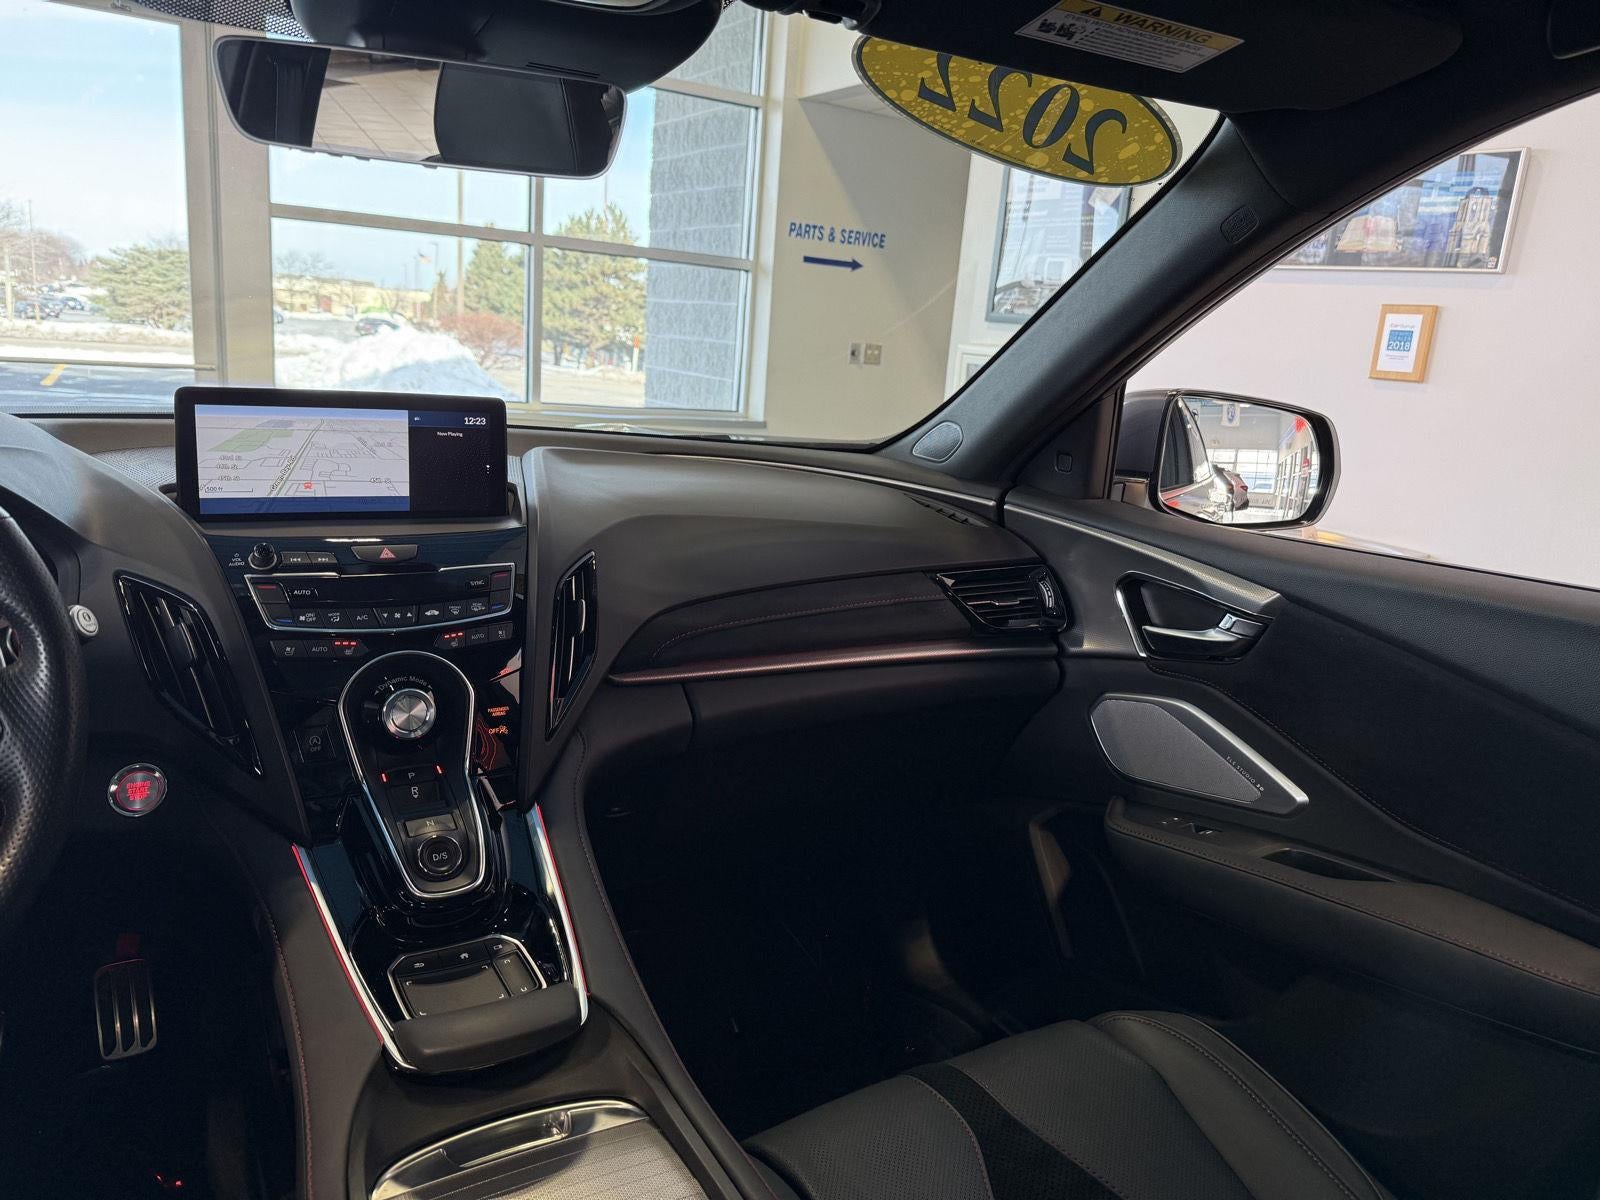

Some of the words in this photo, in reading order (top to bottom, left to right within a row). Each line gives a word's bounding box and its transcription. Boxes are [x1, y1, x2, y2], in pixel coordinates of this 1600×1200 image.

[1114, 12, 1212, 44] WARNING
[789, 222, 824, 241] PARTS
[828, 226, 836, 243] &
[840, 228, 886, 249] SERVICE
[1387, 341, 1411, 351] 2018
[464, 417, 486, 425] 12:23
[378, 675, 408, 691] Dynamic
[409, 675, 428, 687] Mode
[488, 727, 500, 735] OFF
[1236, 765, 1256, 784] STUDIO
[411, 786, 419, 796] R
[432, 851, 448, 862] D/S
